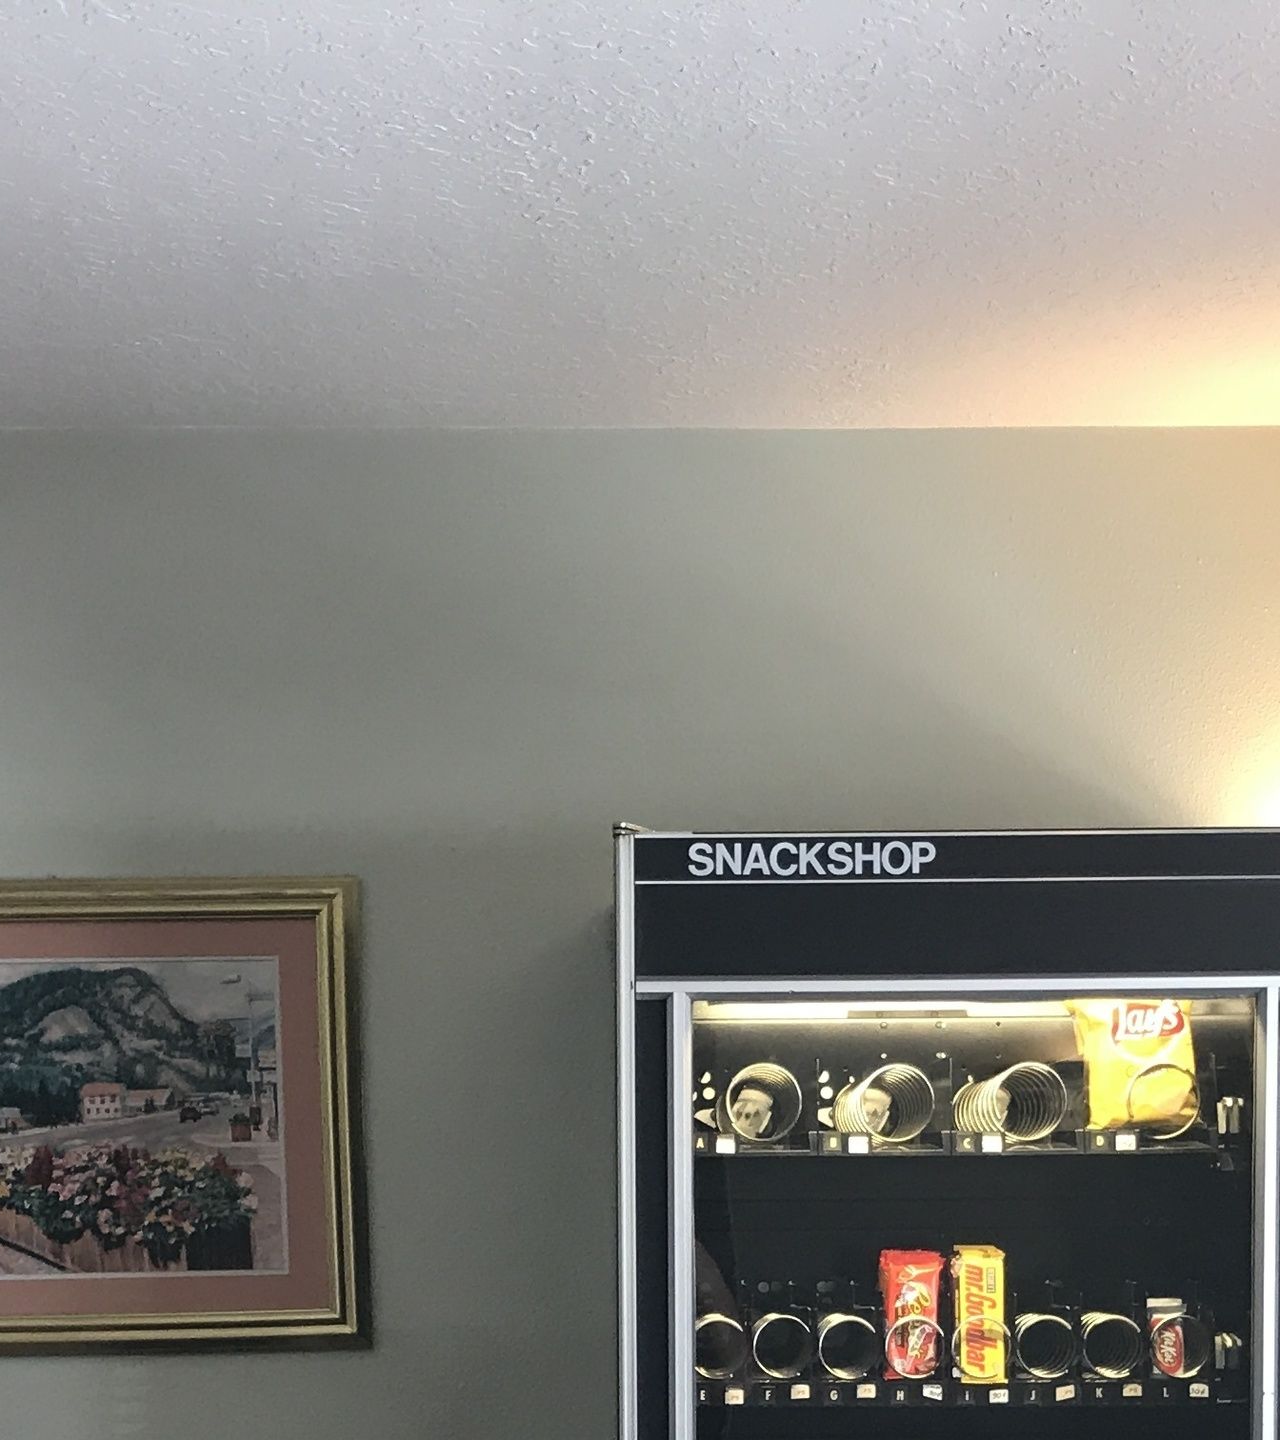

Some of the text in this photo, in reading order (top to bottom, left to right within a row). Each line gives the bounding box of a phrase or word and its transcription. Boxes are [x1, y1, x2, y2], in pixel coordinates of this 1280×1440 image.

[687, 841, 937, 877] SNACKSHOP
[696, 1137, 705, 1149] A
[963, 1137, 971, 1149] C
[1096, 1135, 1104, 1147] D
[700, 1389, 706, 1401] E
[765, 1389, 772, 1401] F
[829, 1389, 838, 1401] G
[896, 1389, 905, 1401] H
[1030, 1389, 1036, 1401] J
[1095, 1387, 1103, 1398] K
[1163, 1387, 1170, 1398] L
